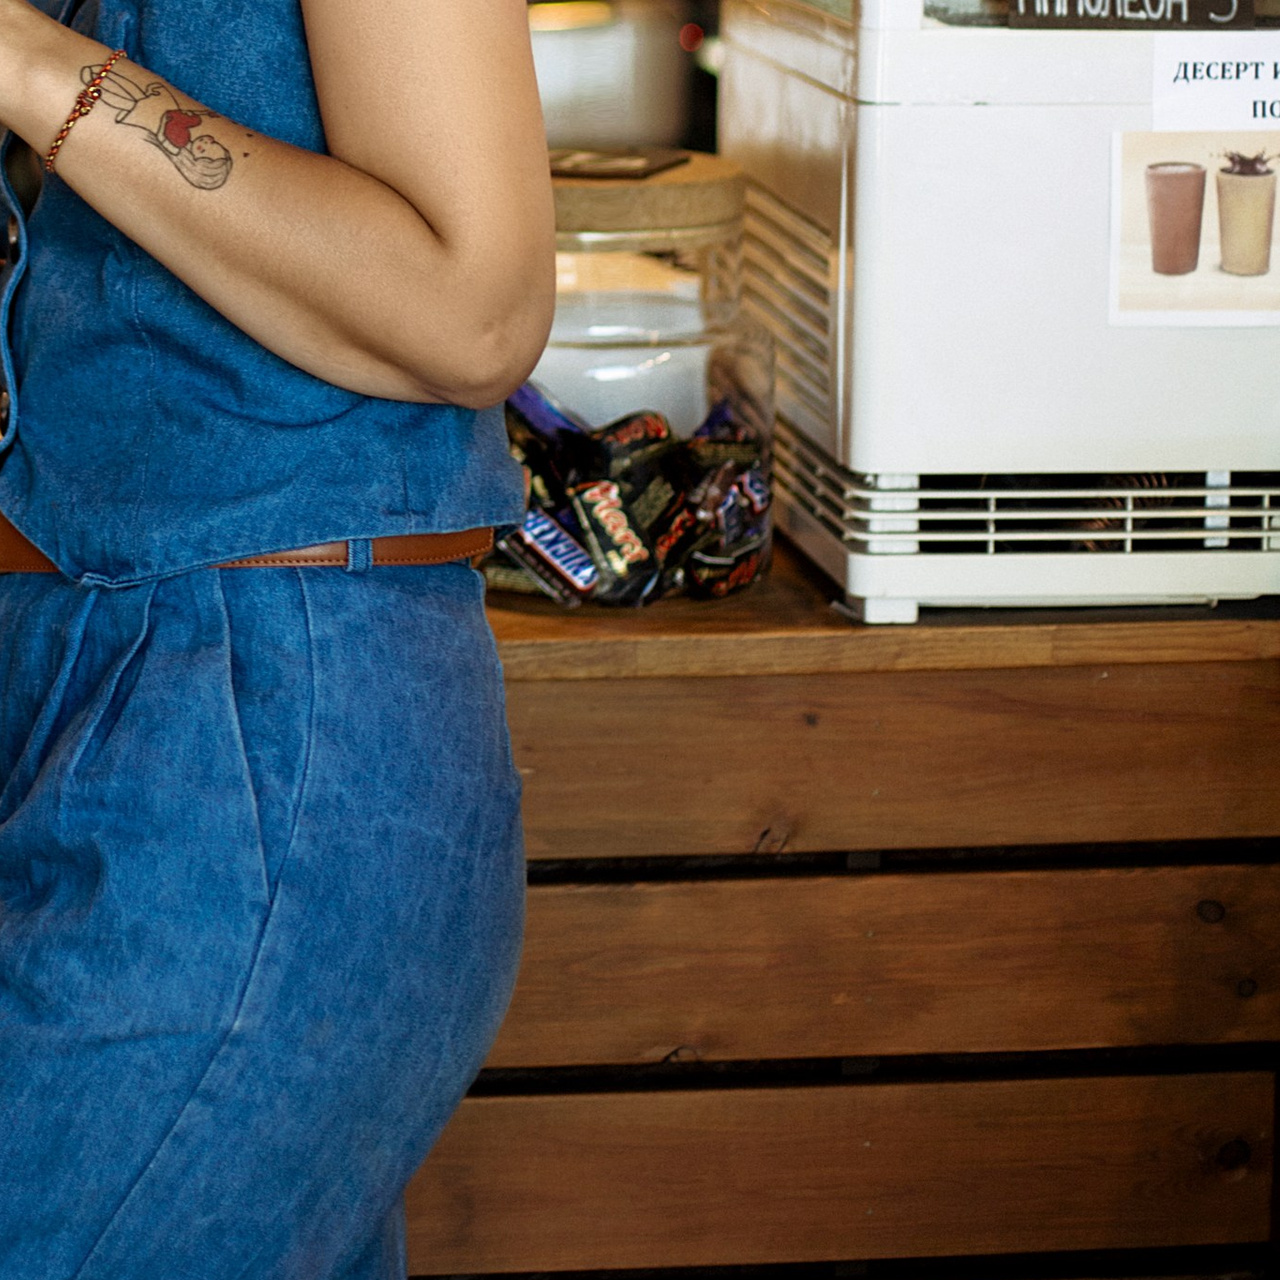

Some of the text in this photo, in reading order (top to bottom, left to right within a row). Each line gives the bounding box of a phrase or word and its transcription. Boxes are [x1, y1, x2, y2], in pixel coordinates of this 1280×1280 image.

[1173, 61, 1265, 83] ДЕСЕРТ
[522, 510, 598, 587] SNICKER
[581, 480, 650, 563] Mars
